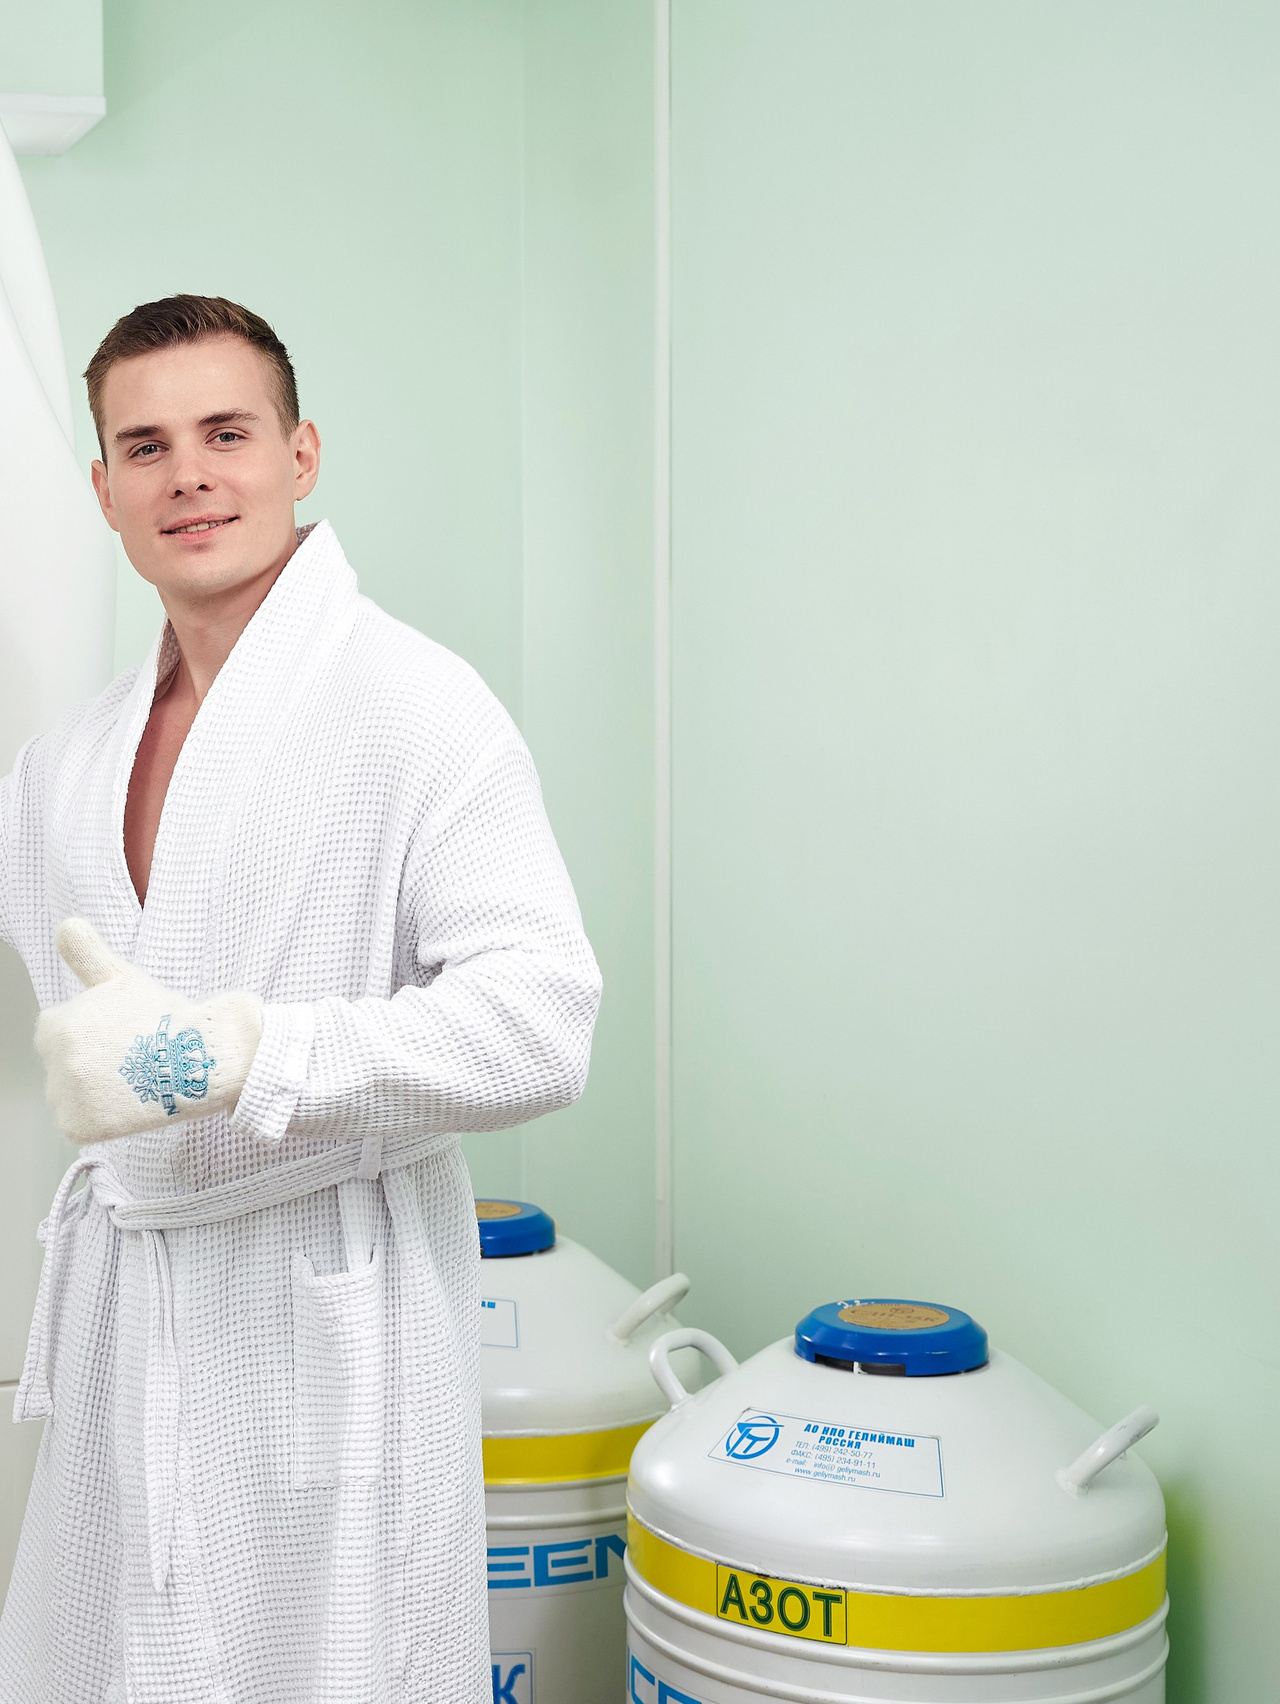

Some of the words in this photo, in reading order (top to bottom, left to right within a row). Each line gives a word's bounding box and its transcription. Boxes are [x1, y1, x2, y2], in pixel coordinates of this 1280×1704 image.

[804, 1423, 819, 1434] АО
[821, 1426, 846, 1438] НПО
[848, 1430, 915, 1448] ГЕЛИЙМАШ
[818, 1436, 862, 1450] РОССИЯ
[812, 1443, 832, 1453] (499)
[833, 1447, 873, 1459] 242-50-77
[815, 1453, 835, 1462] (495)
[836, 1456, 876, 1469] 234-91-11
[794, 1466, 856, 1482] www.geliymash.ru
[837, 1465, 881, 1478] geliymash.ru
[720, 1573, 843, 1637] АЗОТ
